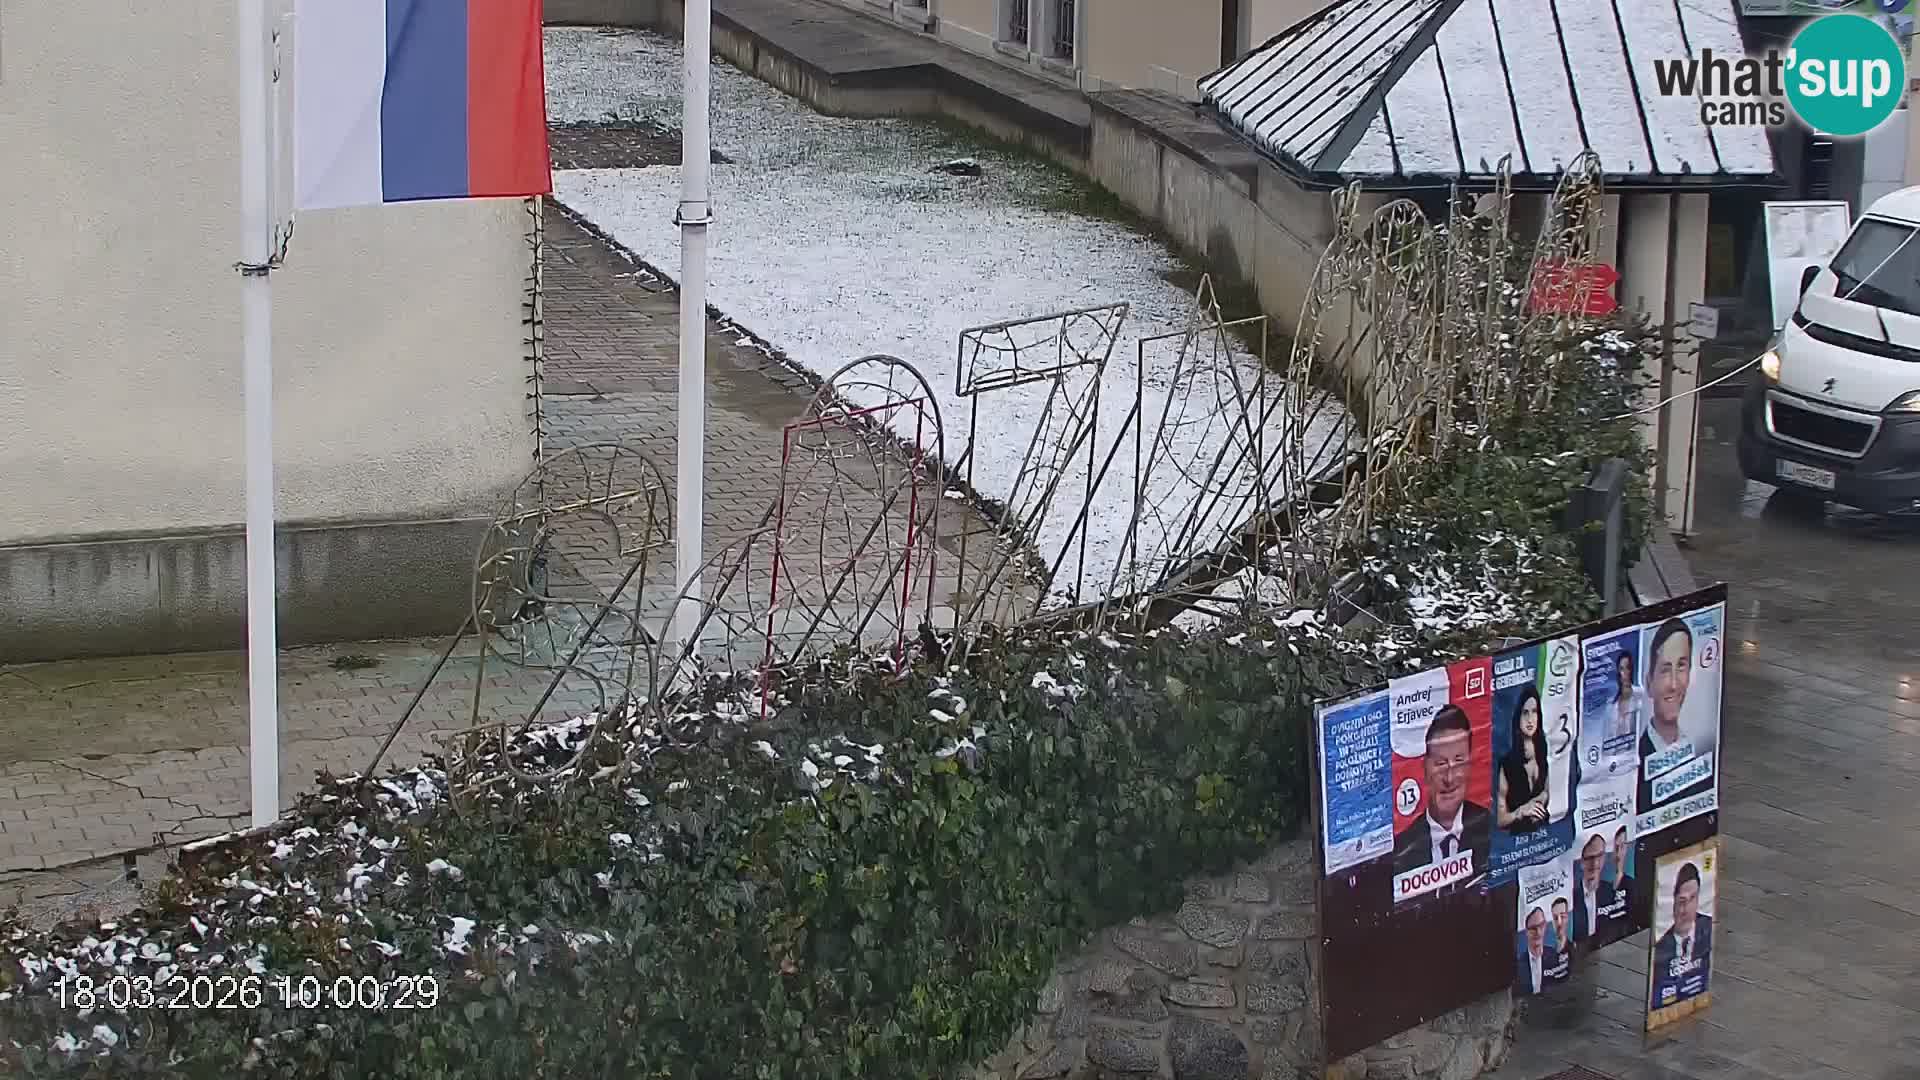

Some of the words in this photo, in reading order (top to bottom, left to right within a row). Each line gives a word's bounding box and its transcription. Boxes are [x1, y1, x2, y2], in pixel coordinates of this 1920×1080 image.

[1396, 685, 1432, 707] Andrej
[1548, 683, 1564, 697] SG
[1397, 706, 1434, 724] Erjavec
[1555, 713, 1571, 754] 3
[1402, 788, 1416, 806] 13
[1401, 858, 1468, 894] DOGOVOR
